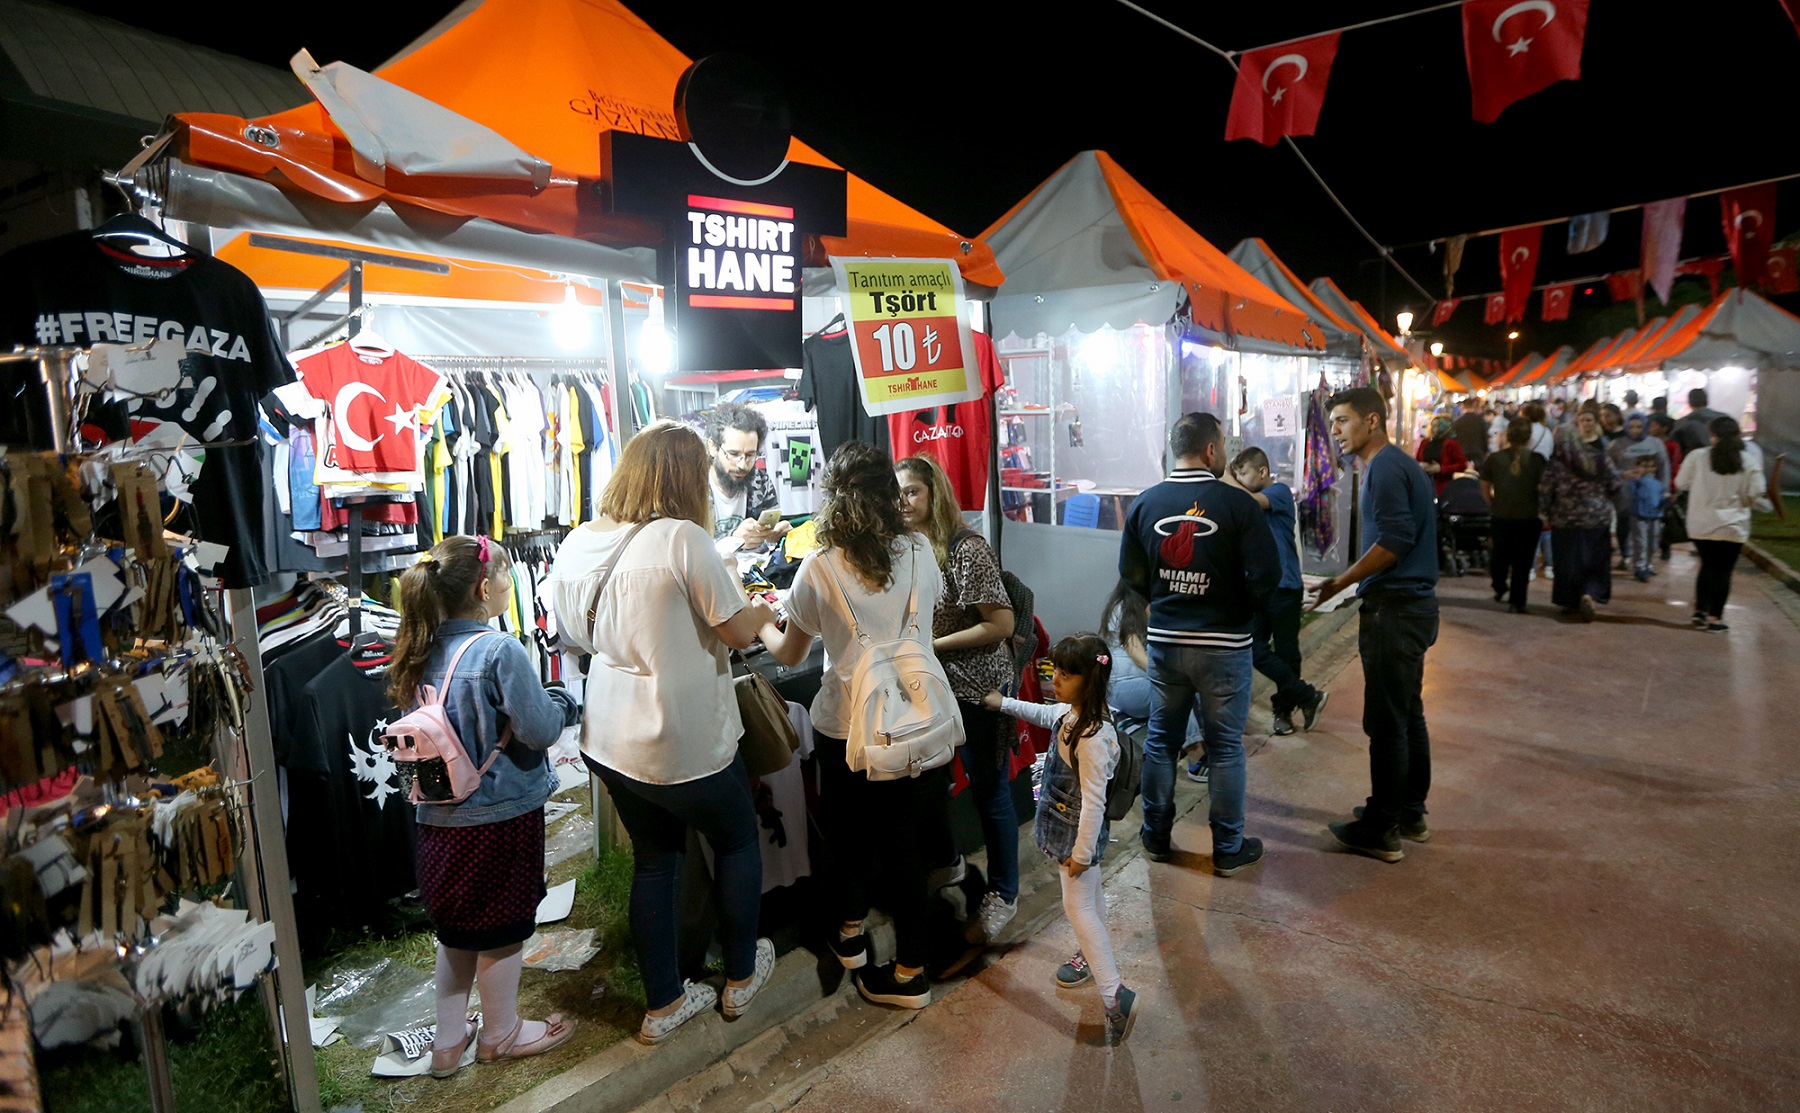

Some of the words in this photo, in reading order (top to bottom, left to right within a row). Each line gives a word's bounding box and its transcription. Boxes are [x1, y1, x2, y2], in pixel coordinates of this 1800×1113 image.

[687, 211, 794, 252] TSHIRT
[687, 247, 794, 293] HANE
[869, 290, 937, 317] Tşört
[35, 312, 252, 363] #FREEGAZA
[872, 321, 917, 372] 10
[1159, 568, 1206, 584] MIAMI
[1170, 581, 1210, 595] HEAT
